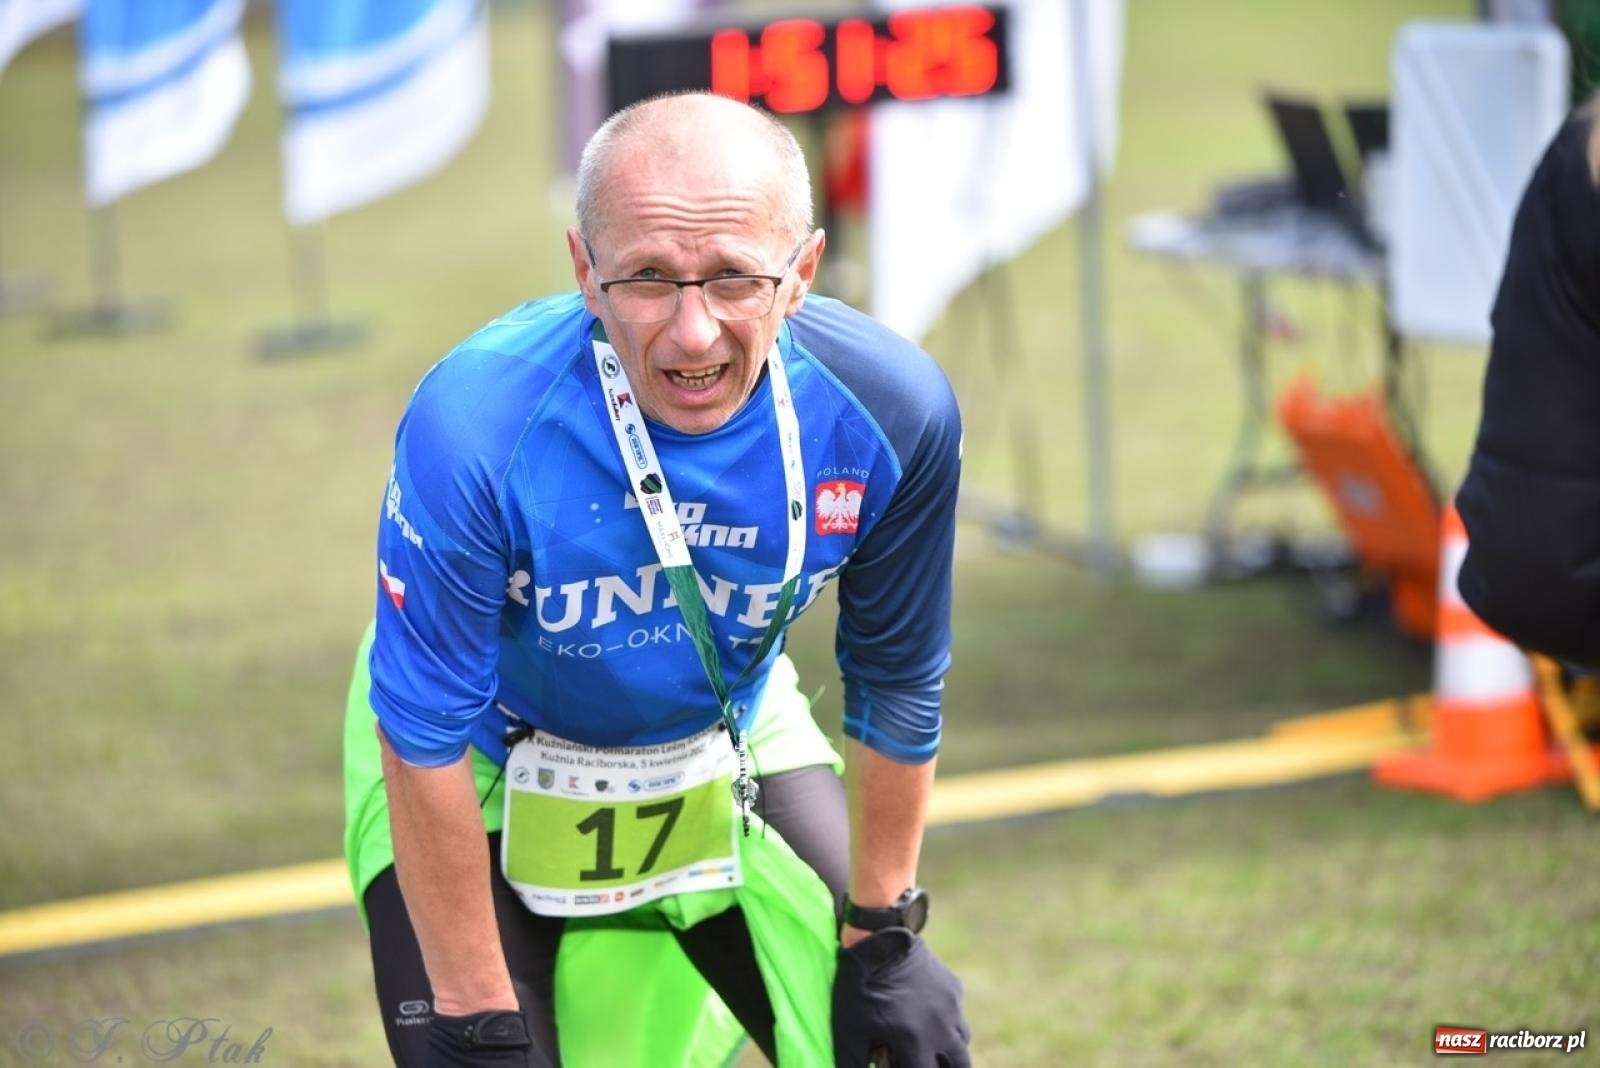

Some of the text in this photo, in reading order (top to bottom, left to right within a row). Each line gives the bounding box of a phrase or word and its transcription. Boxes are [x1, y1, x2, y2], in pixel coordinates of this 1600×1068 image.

[816, 466, 870, 479] POLAND
[540, 750, 576, 765] Kuźnia
[576, 797, 685, 881] 17
